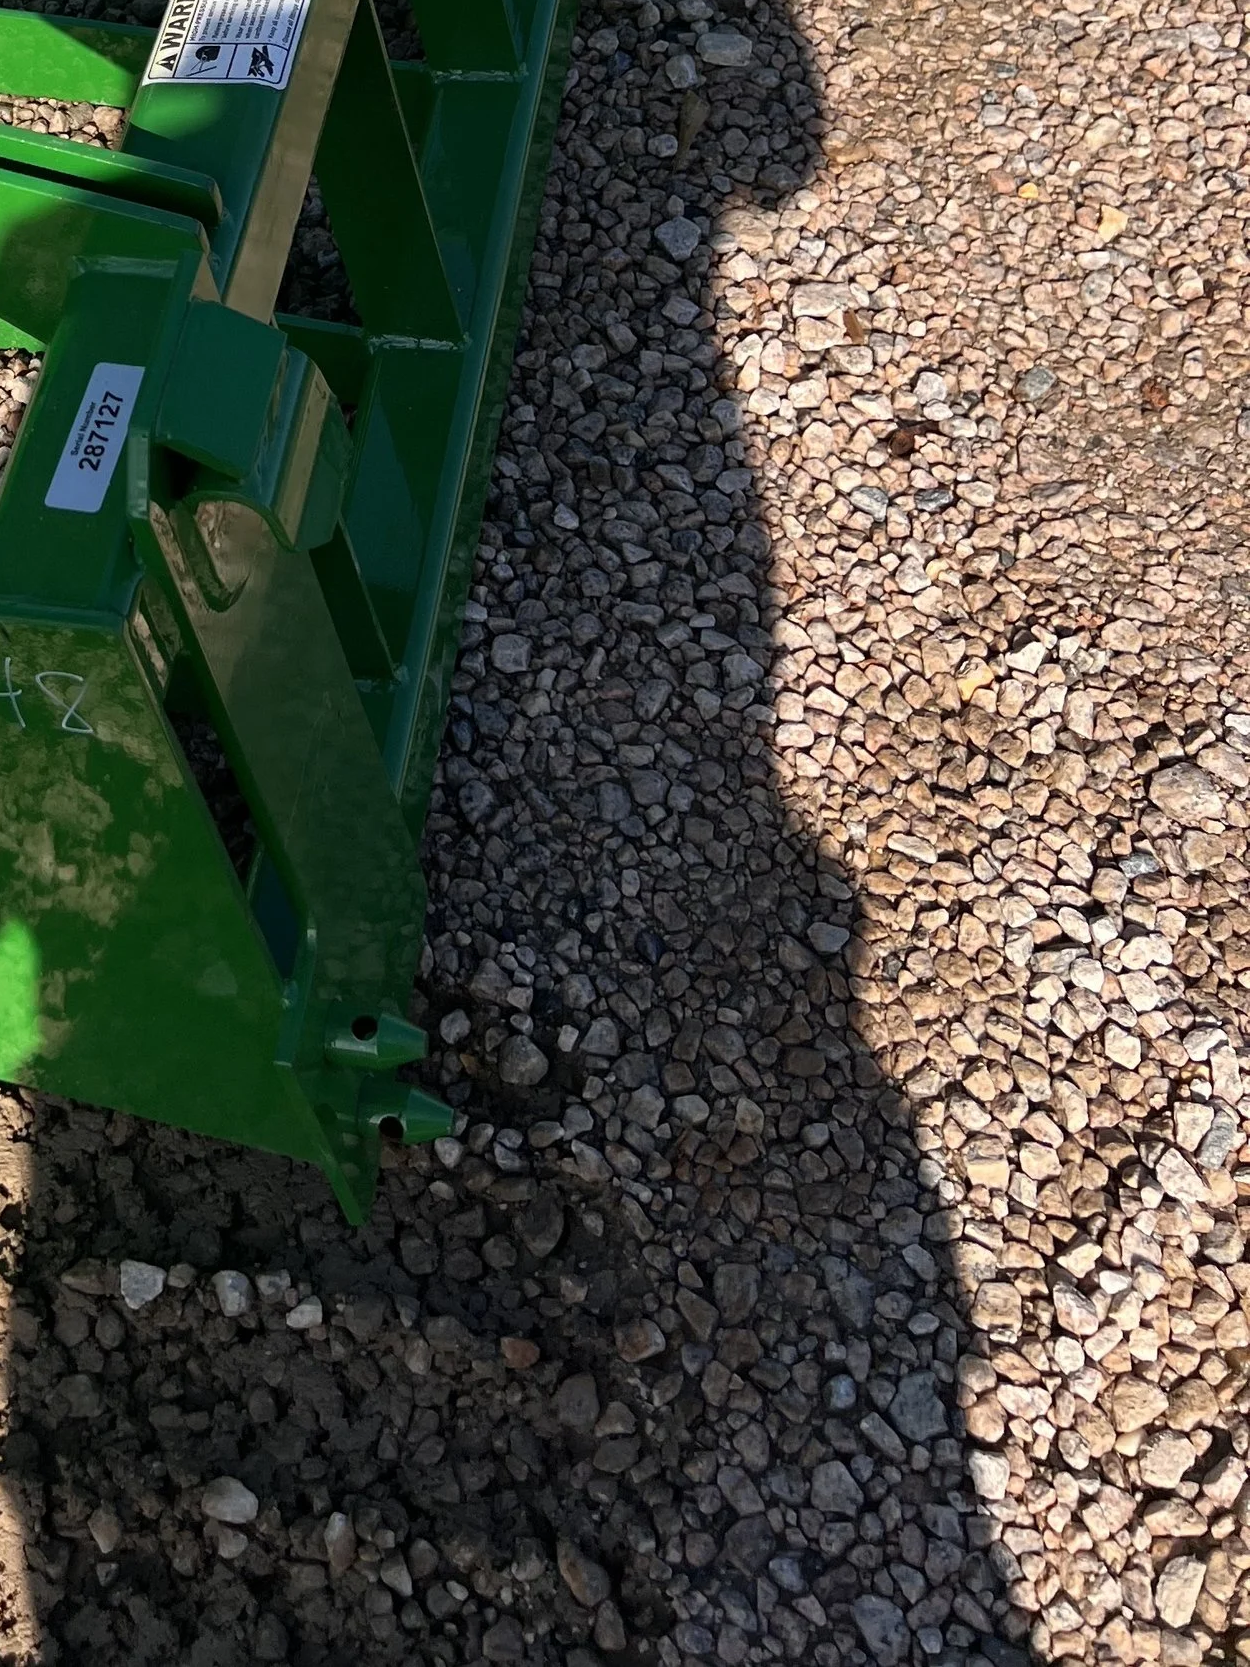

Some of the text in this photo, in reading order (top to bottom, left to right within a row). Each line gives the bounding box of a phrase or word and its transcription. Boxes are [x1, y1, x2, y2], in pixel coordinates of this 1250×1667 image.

[71, 402, 97, 456] Serial Number
[79, 391, 124, 472] 287127
